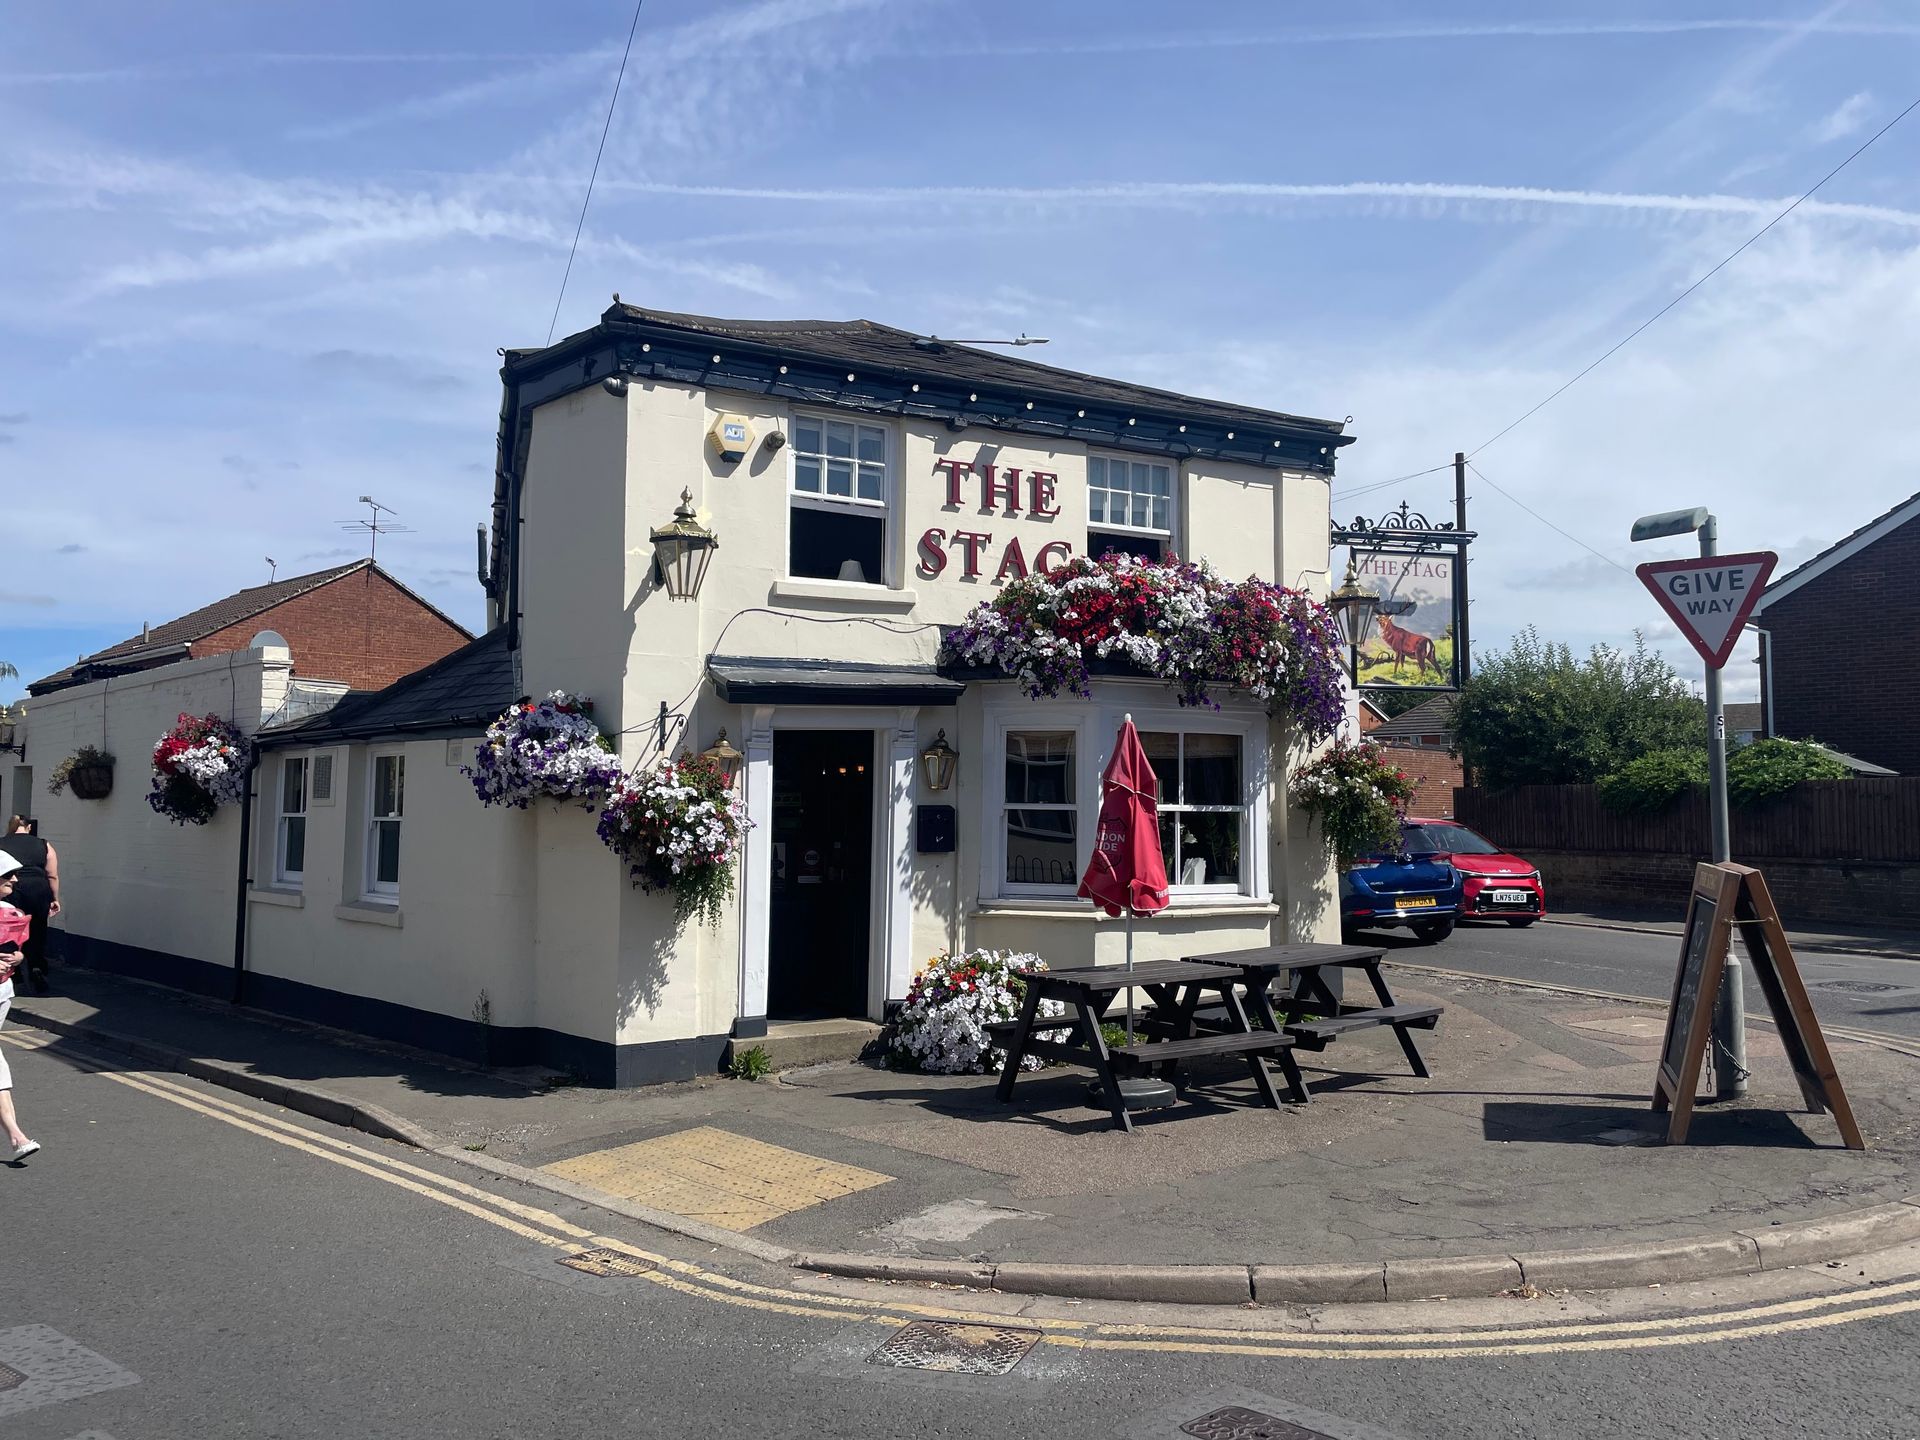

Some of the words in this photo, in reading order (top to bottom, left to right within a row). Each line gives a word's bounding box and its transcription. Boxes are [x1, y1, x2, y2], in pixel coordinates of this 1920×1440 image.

[725, 427, 746, 439] ADT
[937, 457, 1062, 516] THE
[1361, 559, 1398, 576] THE
[1401, 561, 1448, 579] STAG
[1668, 569, 1745, 596] GIVE
[1687, 598, 1735, 616] WAY
